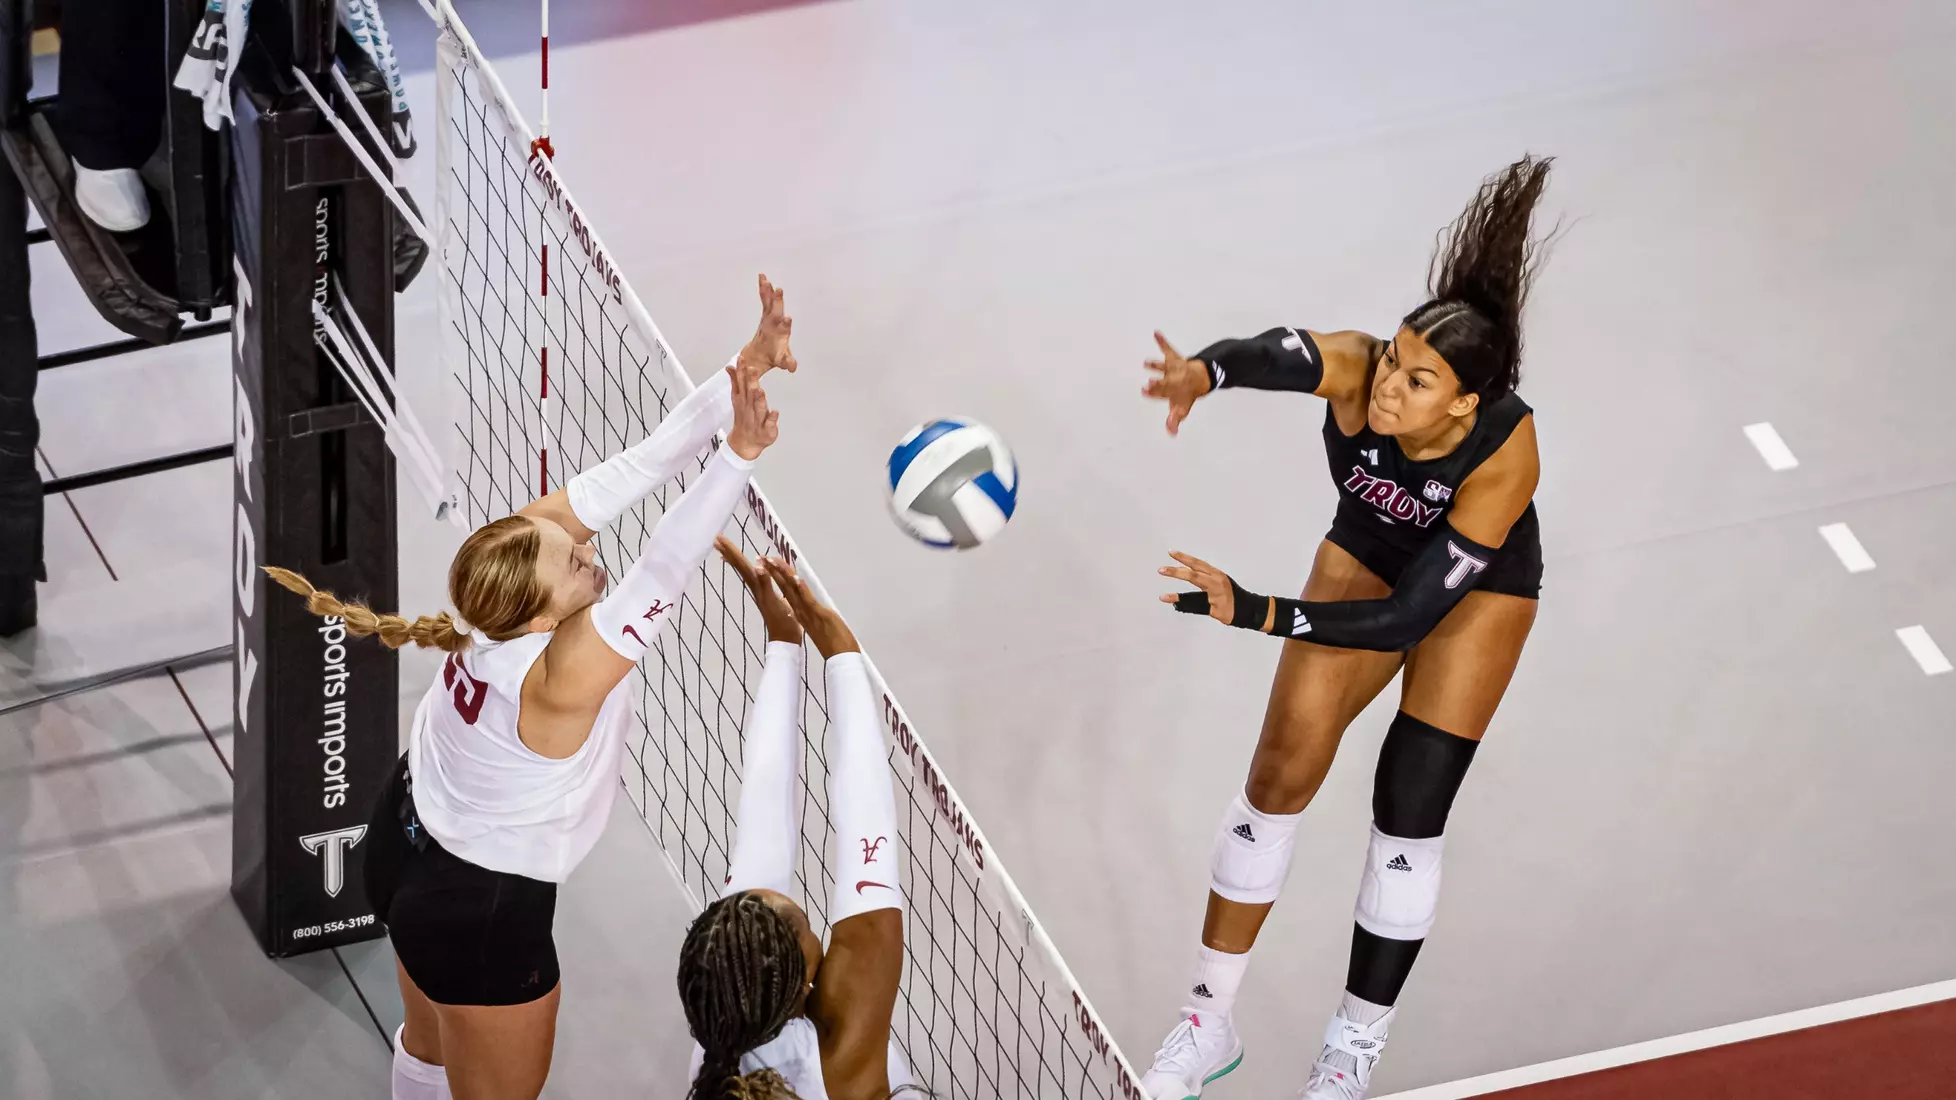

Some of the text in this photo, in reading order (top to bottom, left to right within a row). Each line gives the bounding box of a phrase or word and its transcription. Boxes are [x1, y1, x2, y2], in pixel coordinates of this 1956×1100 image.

[565, 199, 623, 306] TROJANS
[1344, 465, 1443, 528] TROY
[1444, 540, 1488, 589] T
[317, 613, 350, 809] sports imports
[883, 693, 984, 871] TROY TROJANS
[299, 824, 368, 898] T
[1232, 827, 1256, 843] adidas
[1386, 863, 1413, 872] adidas
[293, 914, 375, 939] (800) 556-3198
[1072, 990, 1110, 1067] TROY
